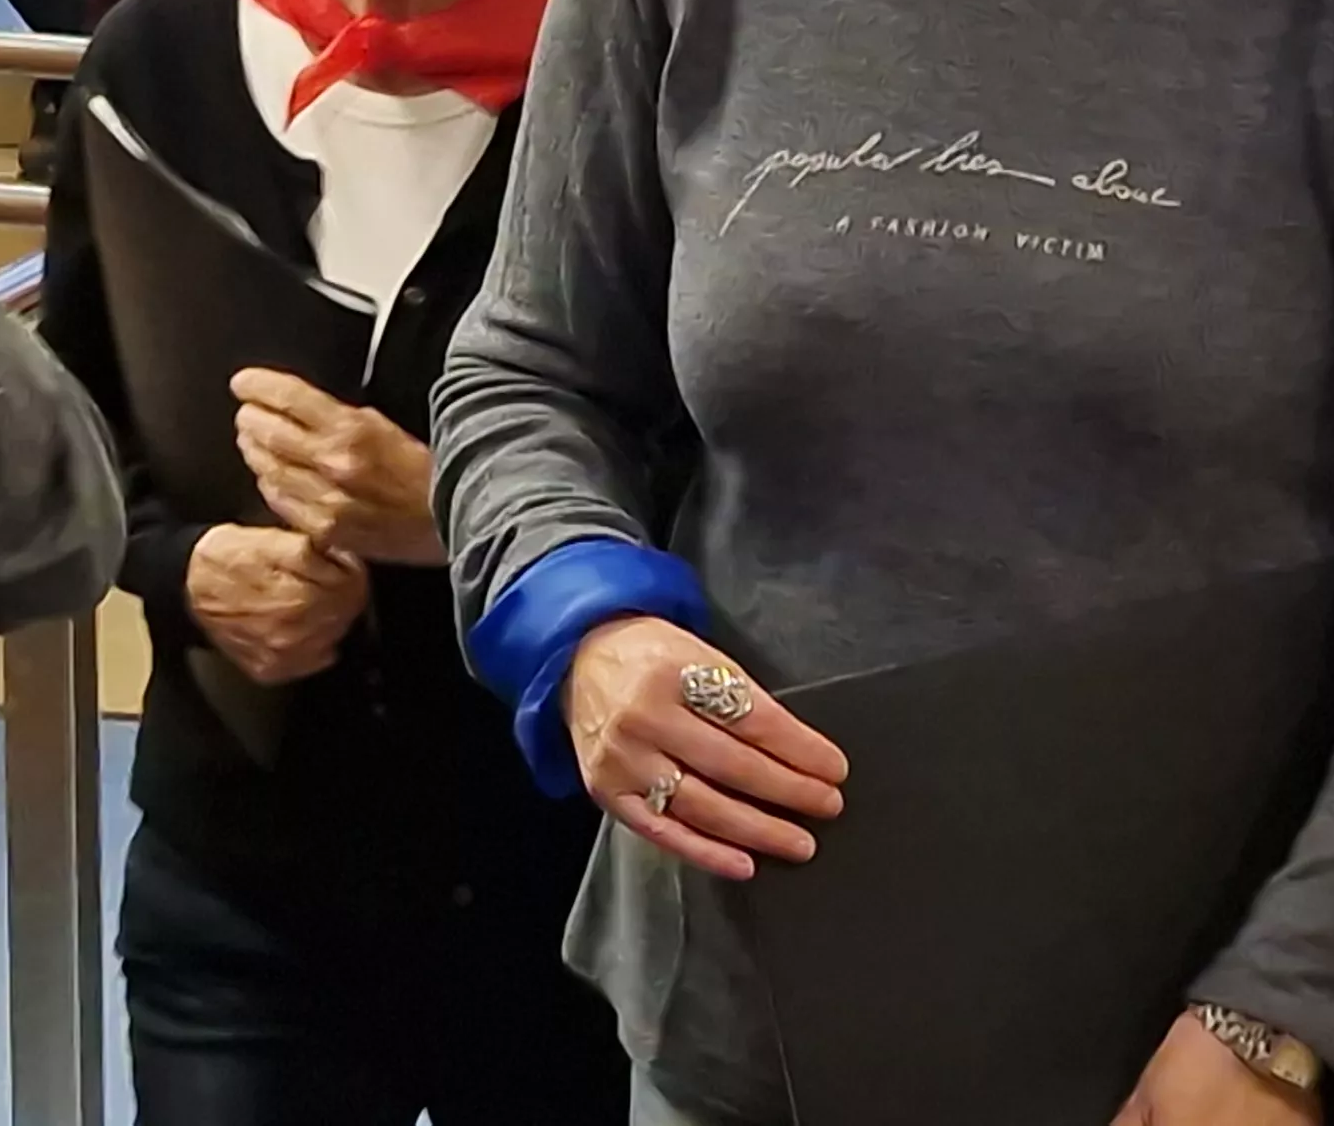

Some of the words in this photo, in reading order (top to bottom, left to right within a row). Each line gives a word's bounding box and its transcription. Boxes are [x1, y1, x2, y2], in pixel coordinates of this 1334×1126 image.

[834, 214, 851, 236] A
[870, 215, 991, 242] FASHION
[1016, 231, 1105, 262] VICTIM
